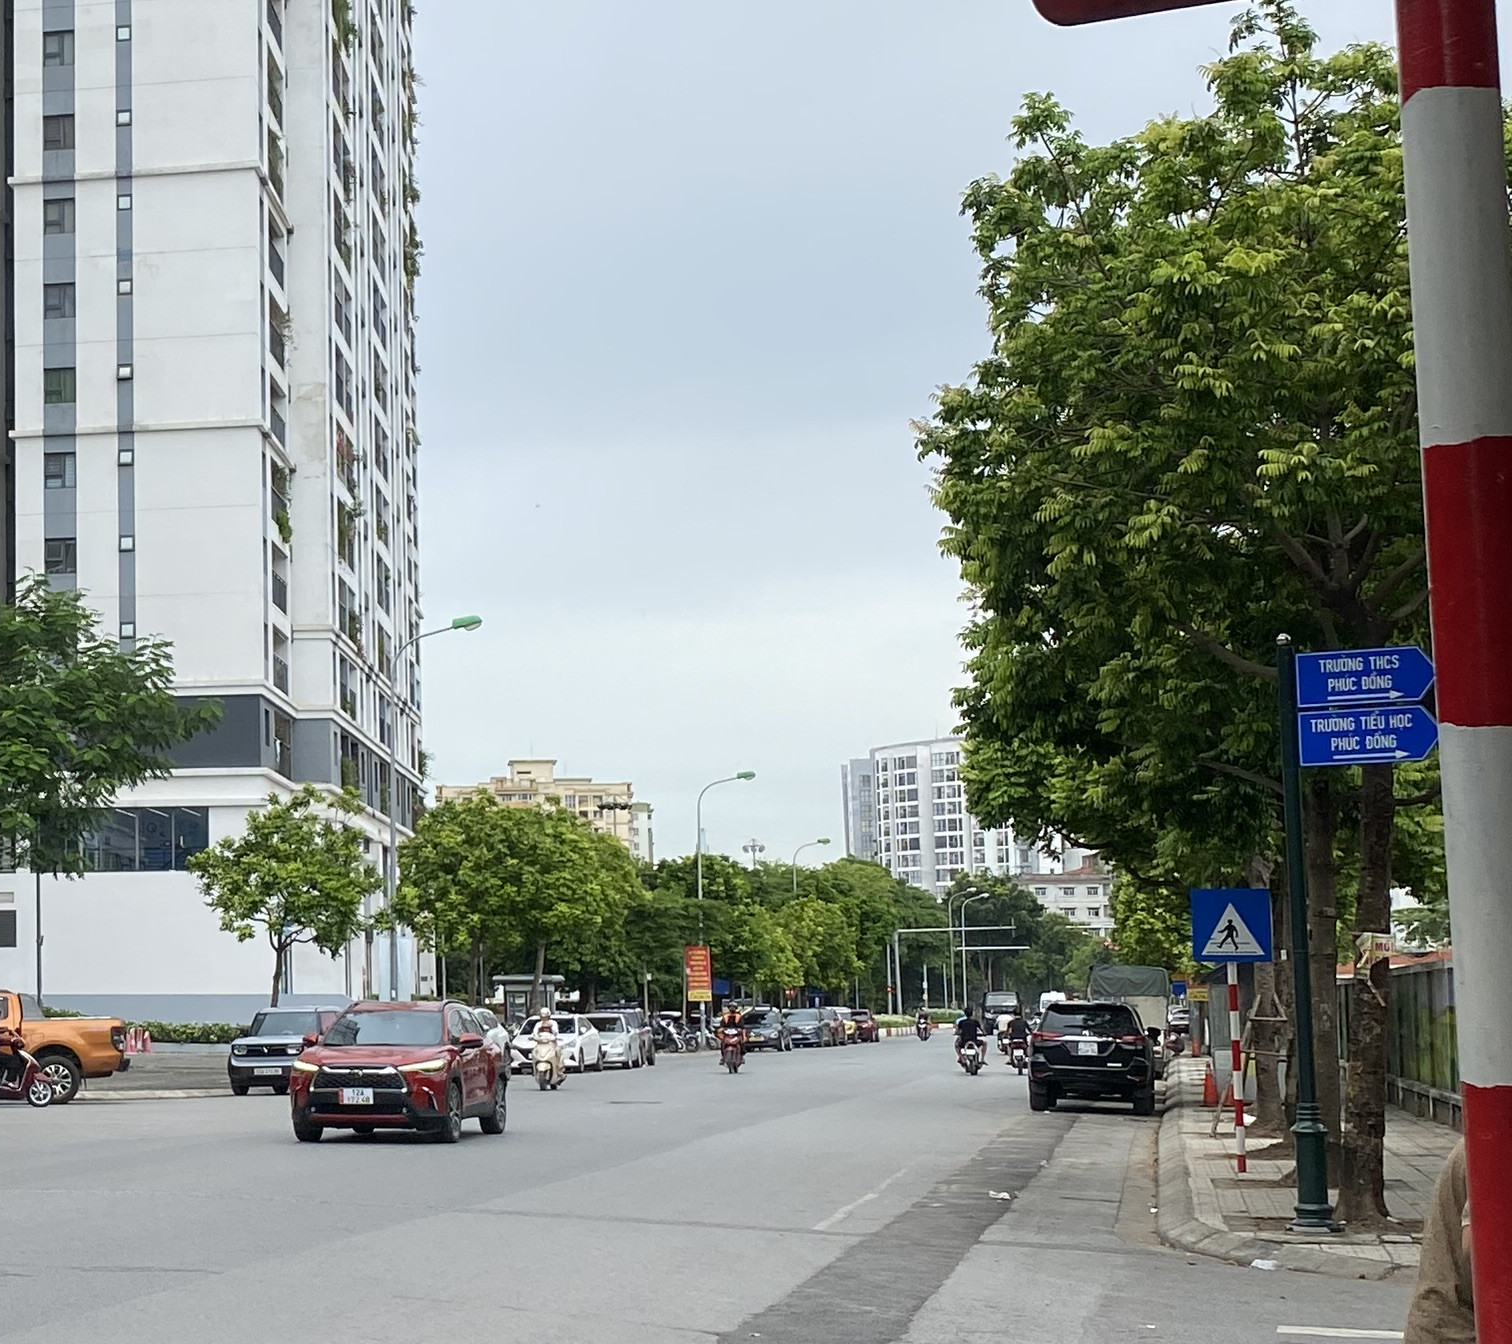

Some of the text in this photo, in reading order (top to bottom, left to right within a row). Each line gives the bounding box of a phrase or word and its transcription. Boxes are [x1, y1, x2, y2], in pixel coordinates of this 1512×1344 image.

[1318, 654, 1400, 673] TRƯỜNG THCS
[1328, 671, 1392, 692] PHÚC ĐỒNG
[1310, 711, 1413, 733] TRƯỜNG TIỂU HỌC
[1331, 731, 1397, 751] PHÚC ĐỒNG
